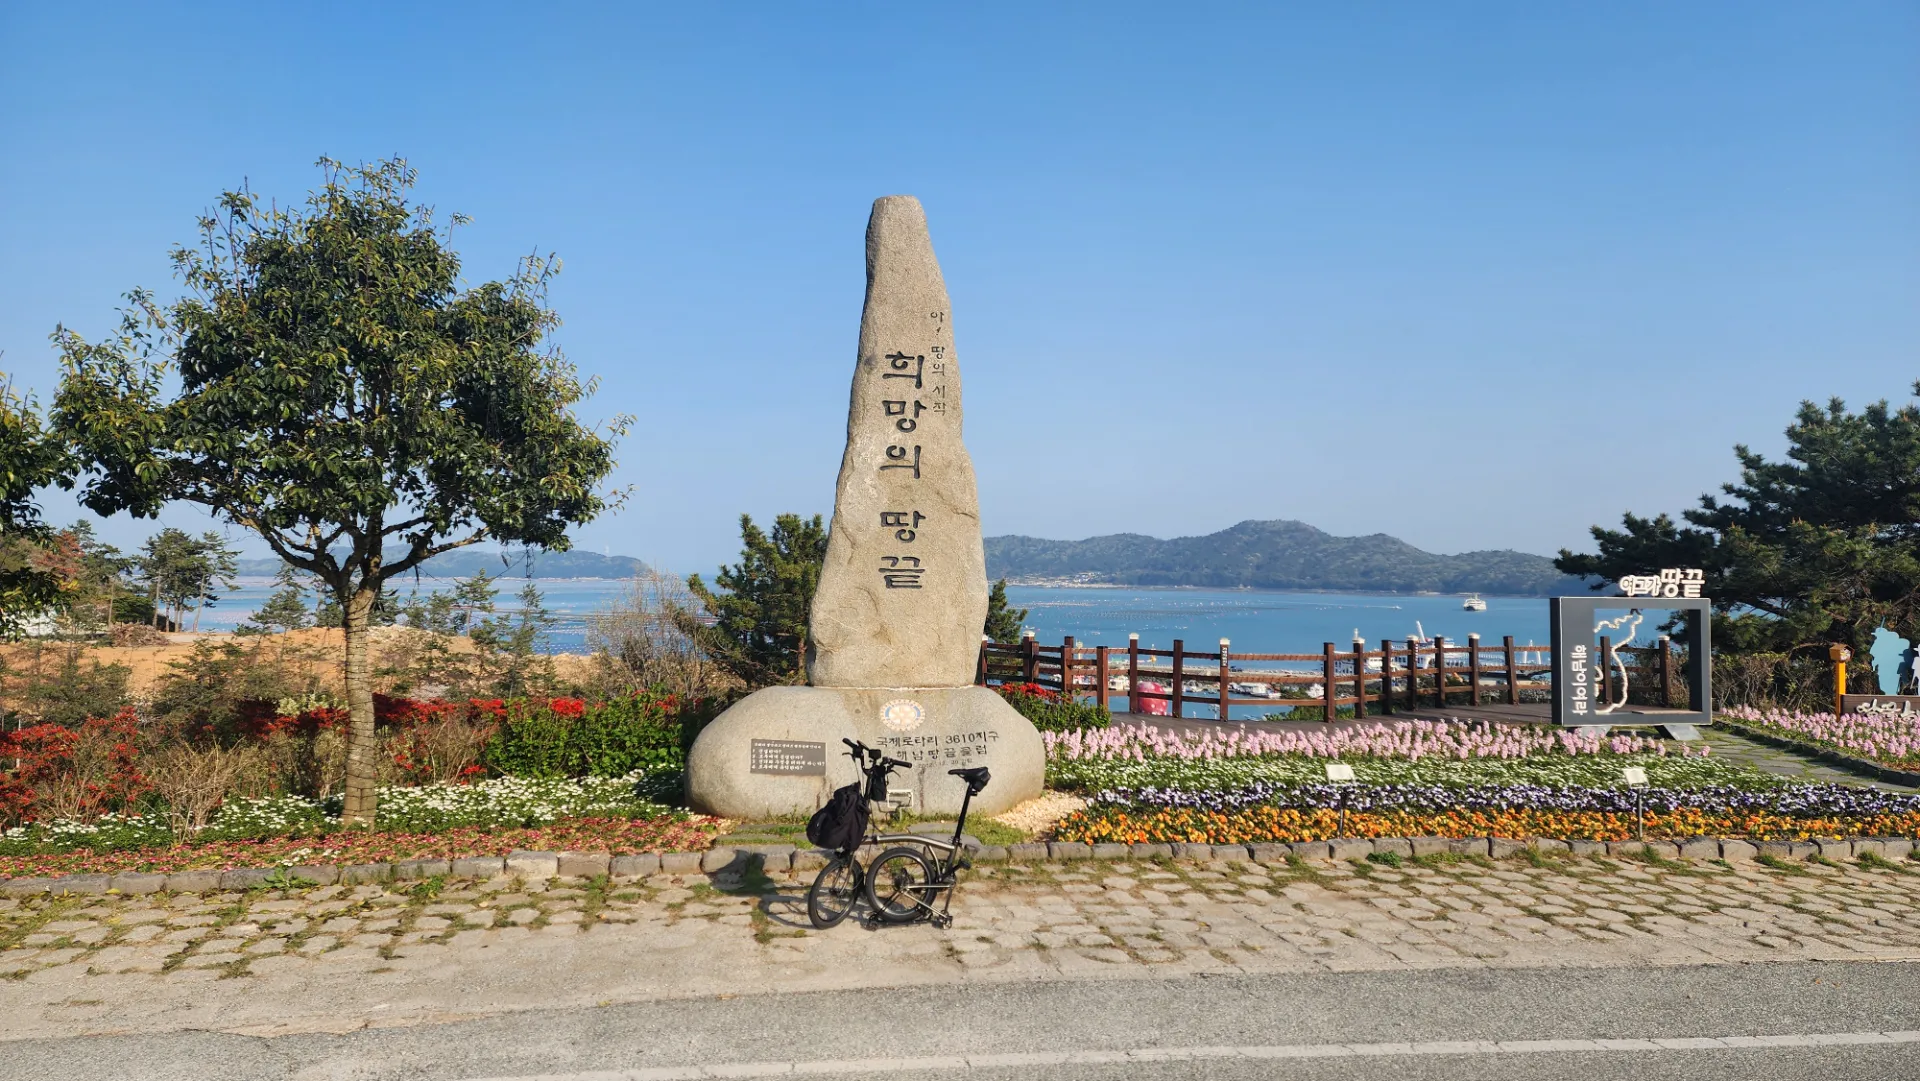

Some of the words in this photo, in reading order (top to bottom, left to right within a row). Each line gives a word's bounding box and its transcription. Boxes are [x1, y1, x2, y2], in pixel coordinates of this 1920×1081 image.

[930, 346, 945, 376] 땅의
[881, 350, 928, 480] 희망의
[932, 385, 946, 417] 시작
[878, 510, 927, 590] 땅끝
[1660, 568, 1706, 598] 땅끝
[1570, 644, 1589, 716] 해남이여라
[876, 735, 938, 747] 국제로타리
[945, 730, 1000, 745] 3610지구
